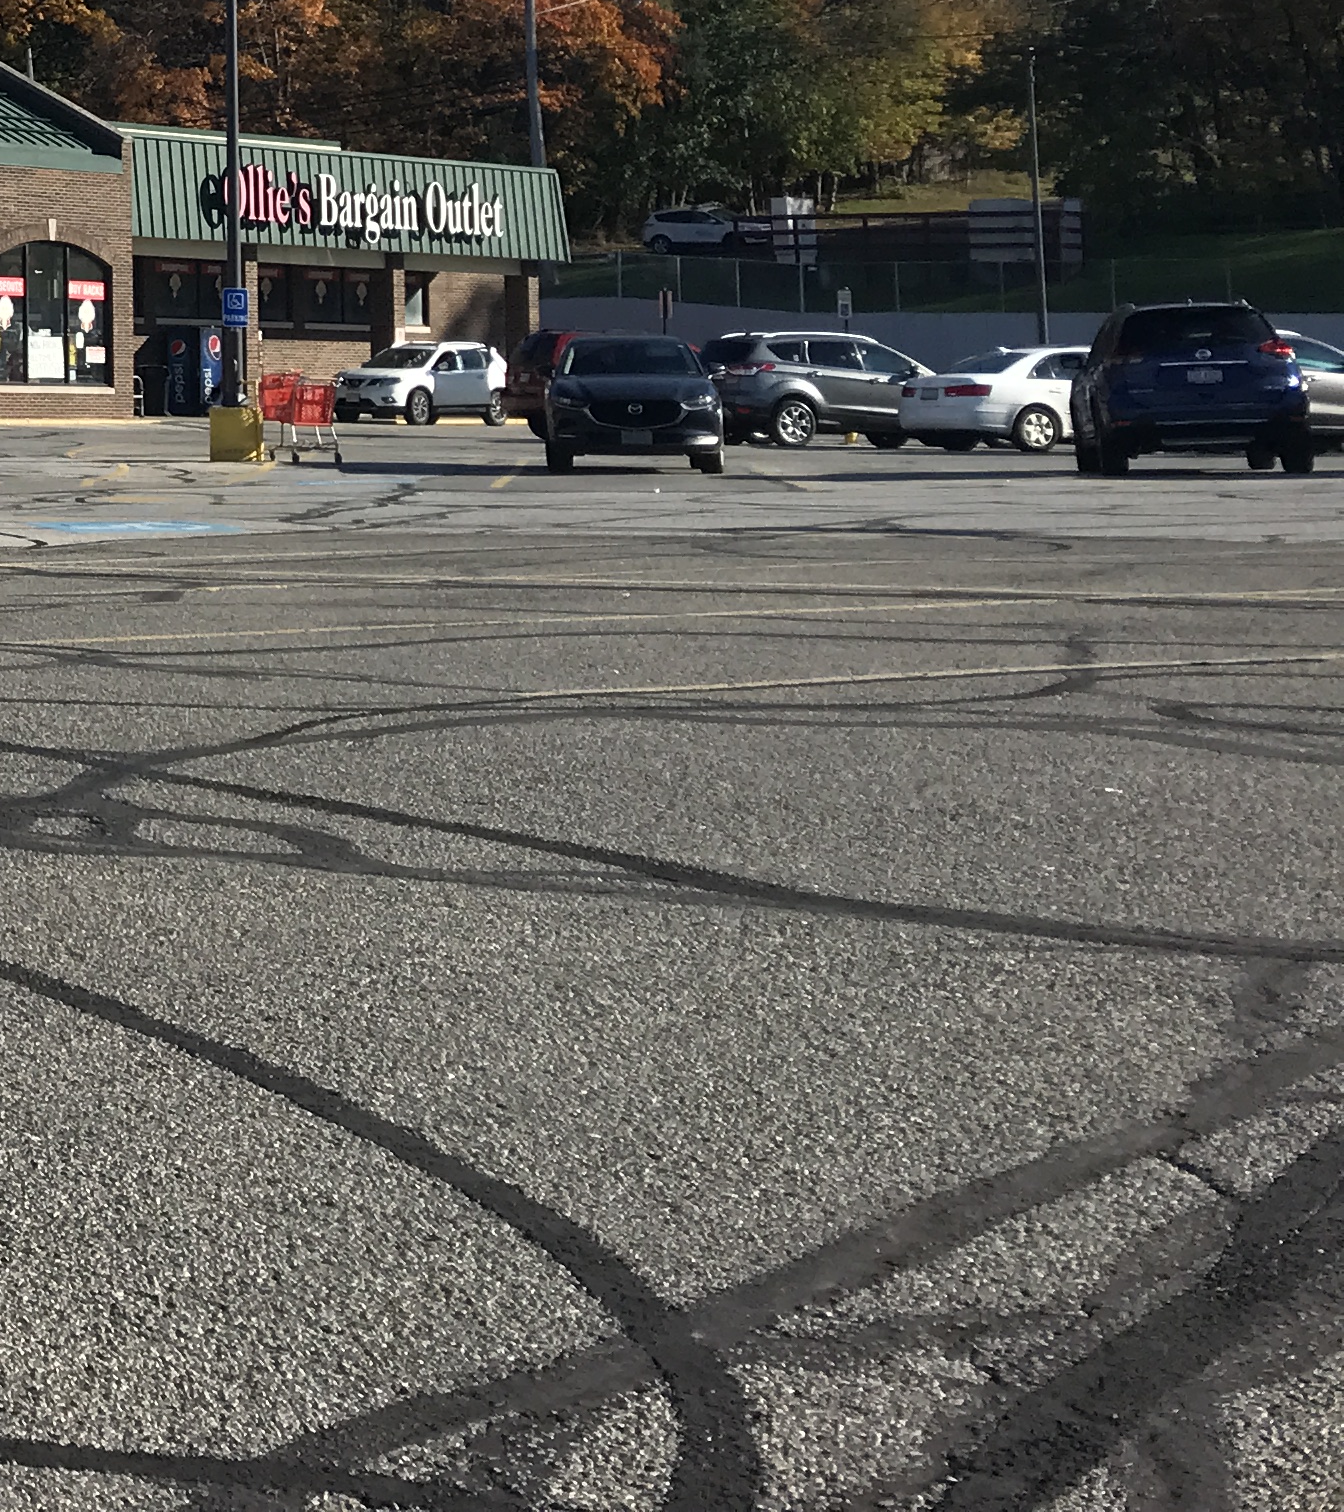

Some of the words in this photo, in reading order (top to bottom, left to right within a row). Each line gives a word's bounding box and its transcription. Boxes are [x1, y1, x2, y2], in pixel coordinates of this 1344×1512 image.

[318, 173, 419, 244] Bargain
[425, 181, 505, 237] Outlet
[69, 282, 82, 295] BUY
[83, 284, 104, 296] BACKS
[173, 364, 186, 403] pepsi
[203, 368, 214, 404] pepsi
